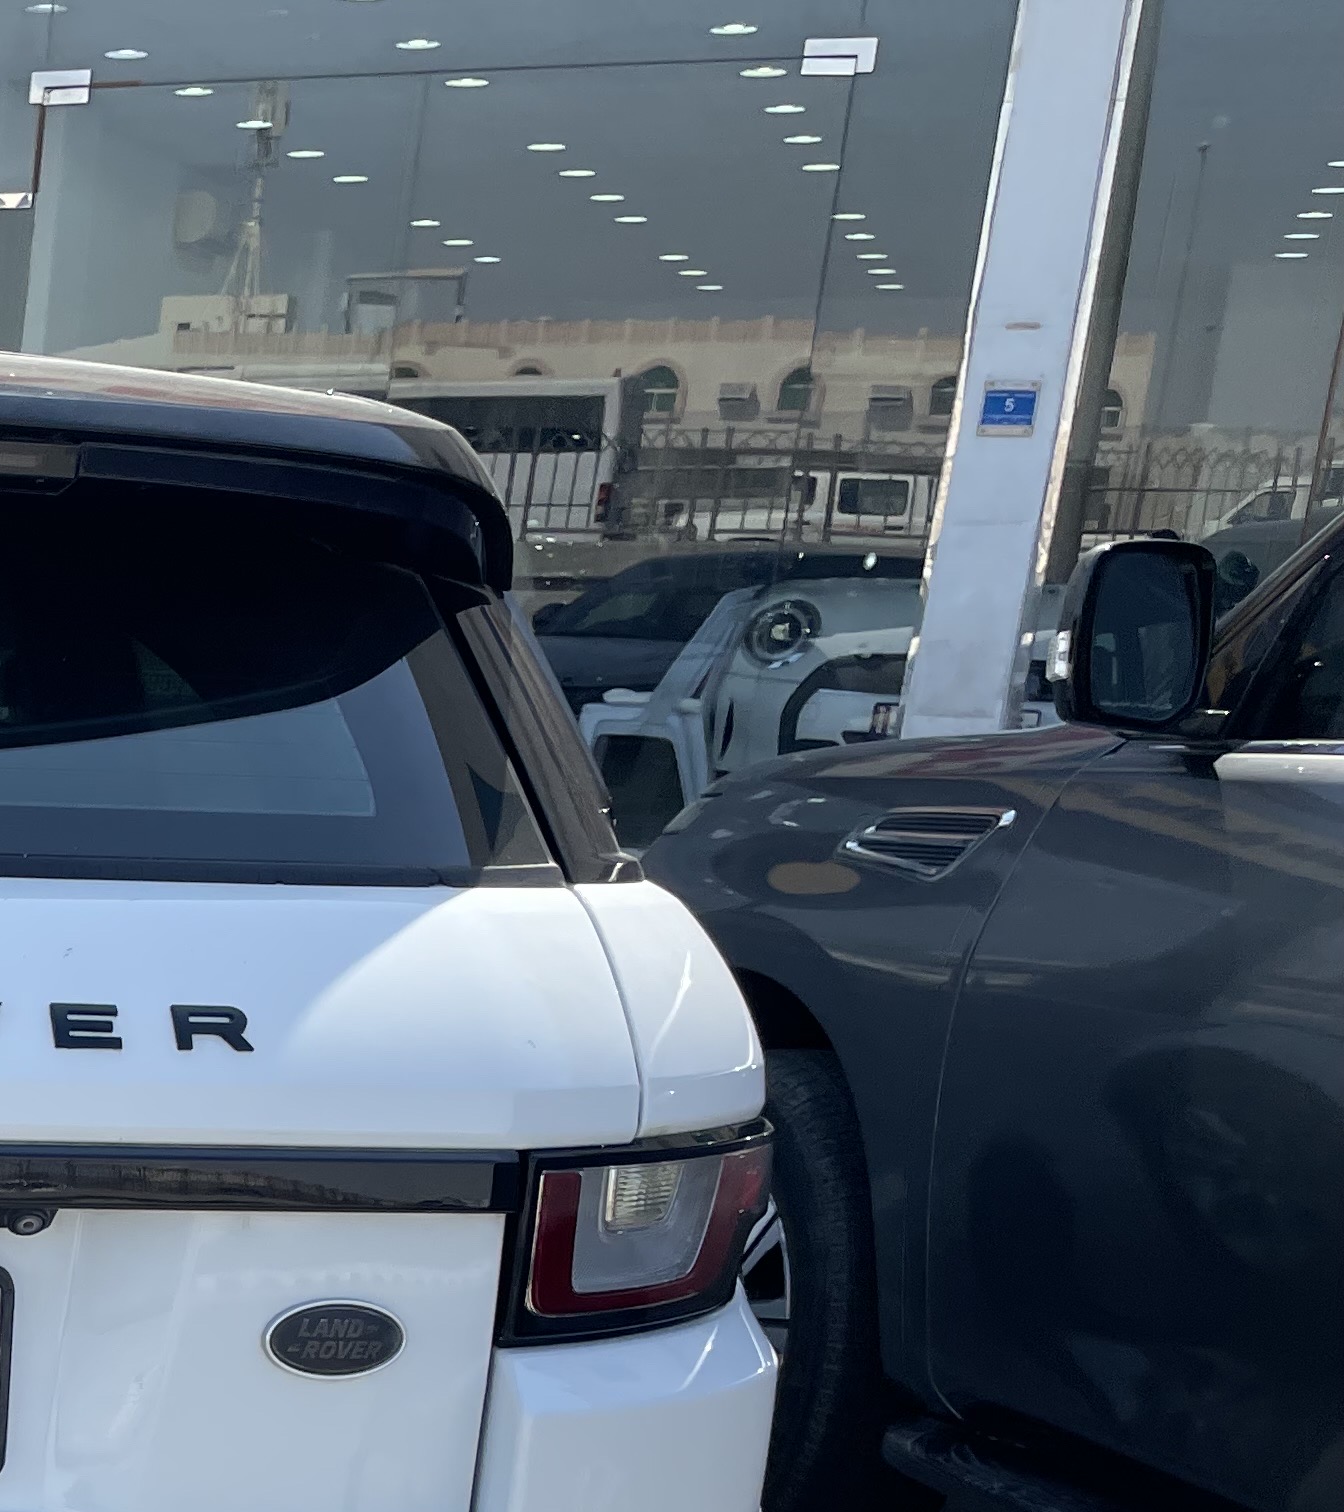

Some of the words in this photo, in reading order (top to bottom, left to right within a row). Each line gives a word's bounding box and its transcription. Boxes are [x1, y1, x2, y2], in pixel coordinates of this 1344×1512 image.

[1004, 397, 1015, 412] 5
[297, 1318, 364, 1339] LAND
[300, 1340, 384, 1360] ROVER
